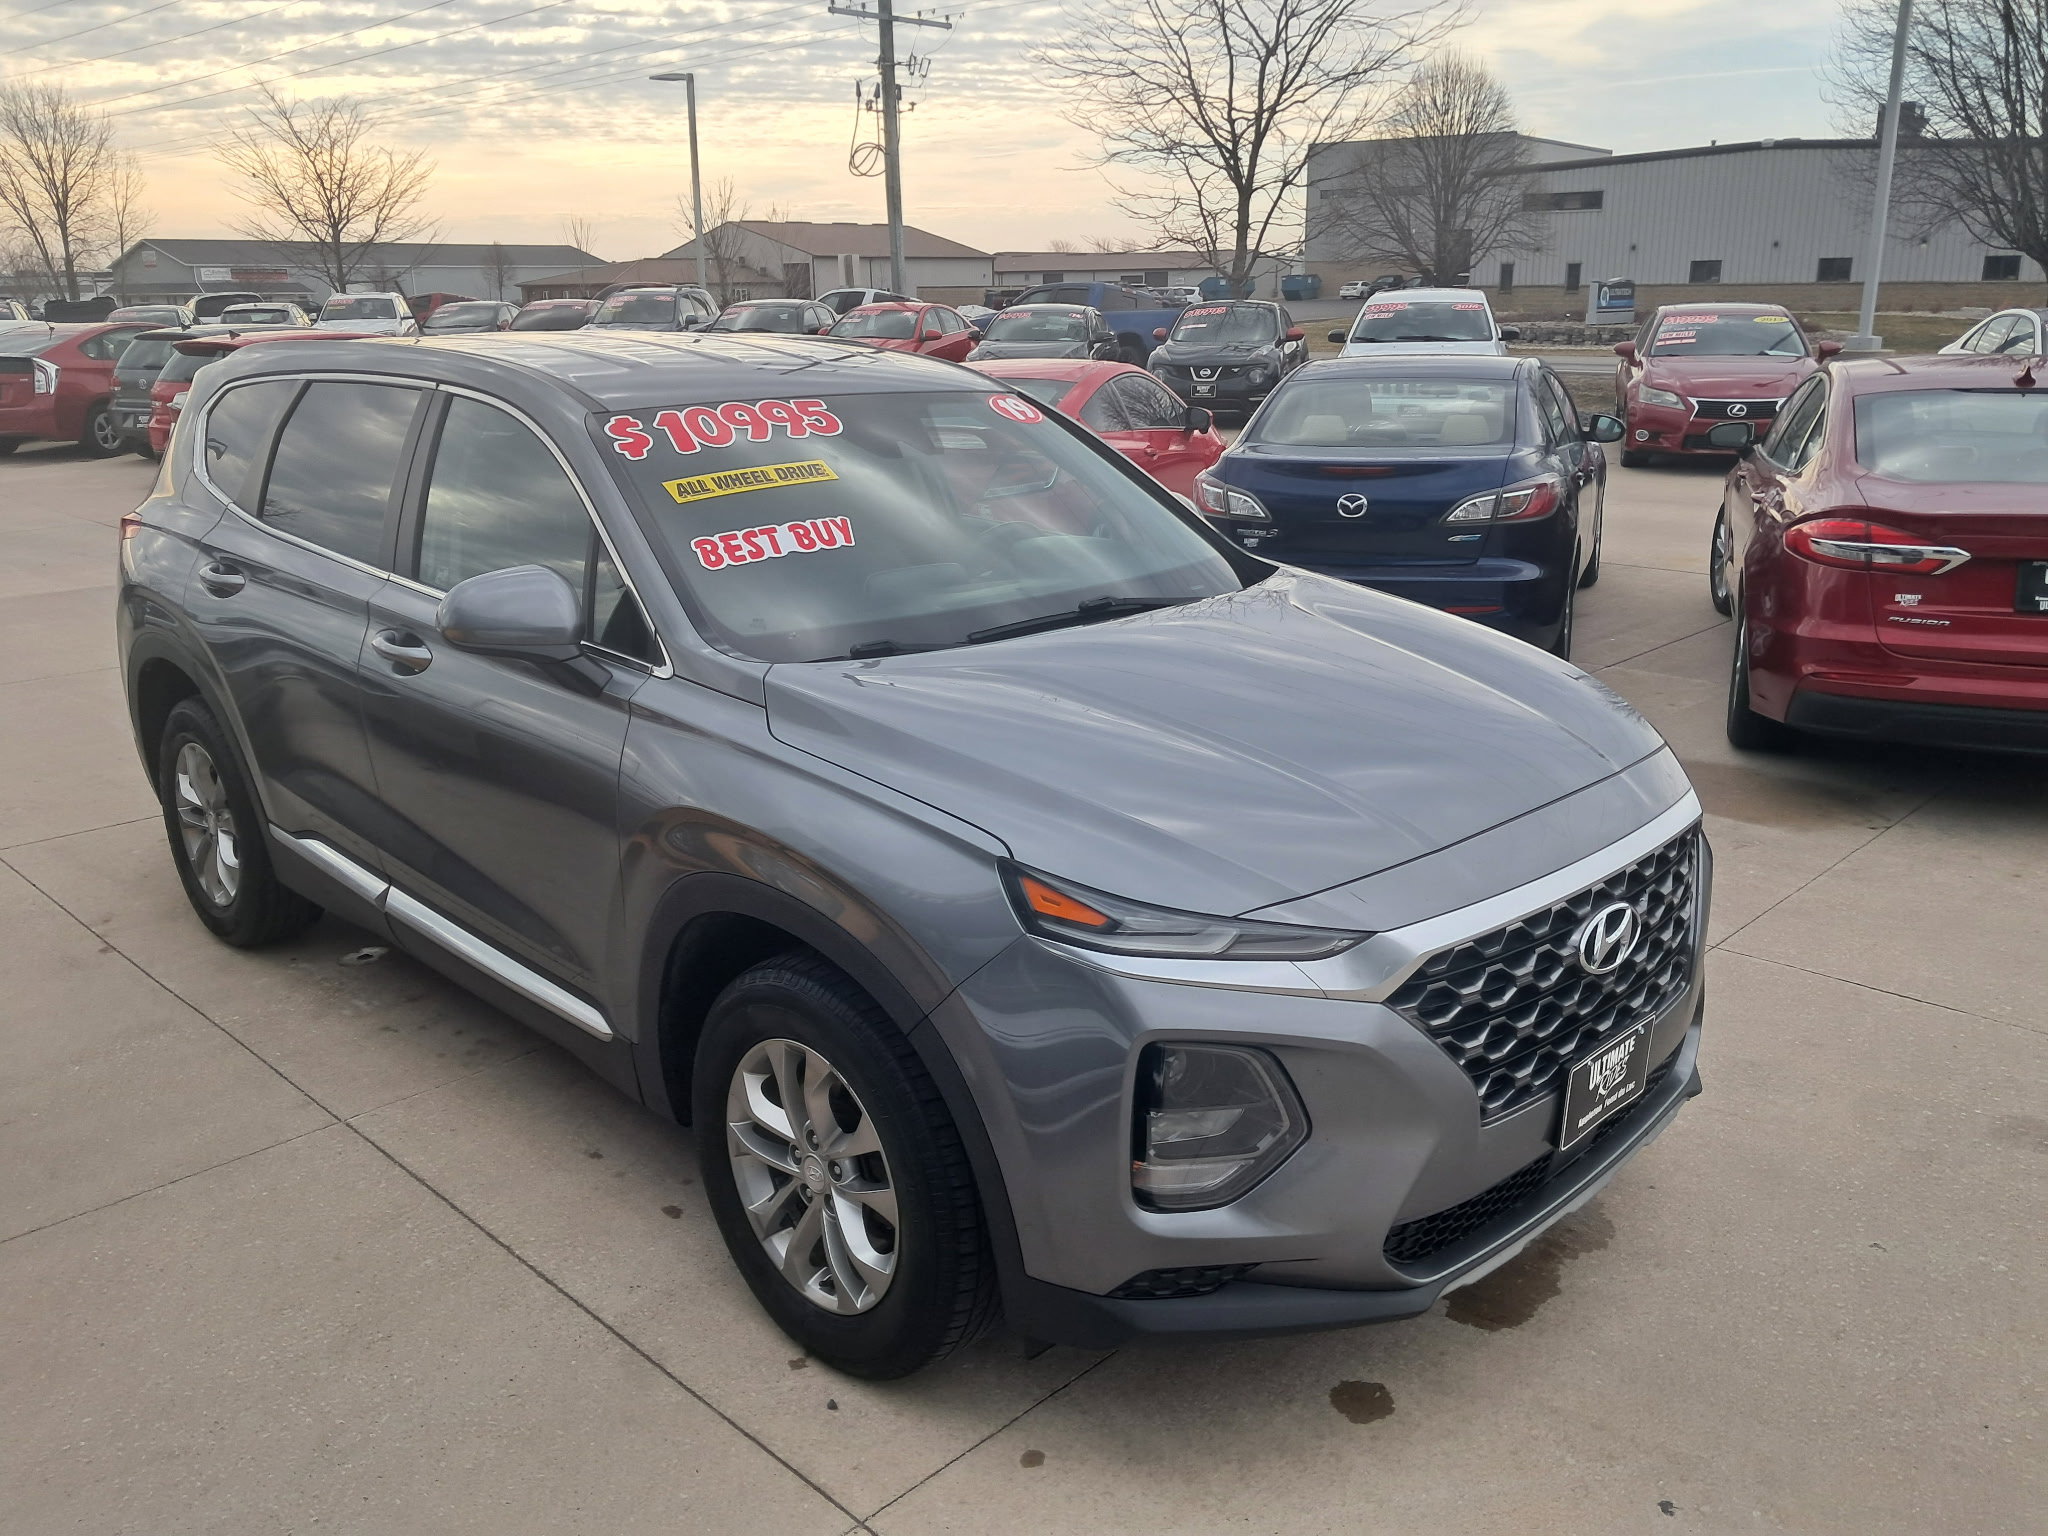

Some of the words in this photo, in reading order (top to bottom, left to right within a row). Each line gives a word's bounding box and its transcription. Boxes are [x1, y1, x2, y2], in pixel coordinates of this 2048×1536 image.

[996, 398, 1036, 420] 19
[676, 480, 715, 499] ALL
[711, 469, 777, 491] WHEEL
[773, 463, 830, 482] DRIVE
[692, 526, 782, 569] BEST
[787, 517, 854, 551] BUY
[1888, 616, 1951, 626] FUSION
[1588, 1035, 1636, 1091] ULTIMATE
